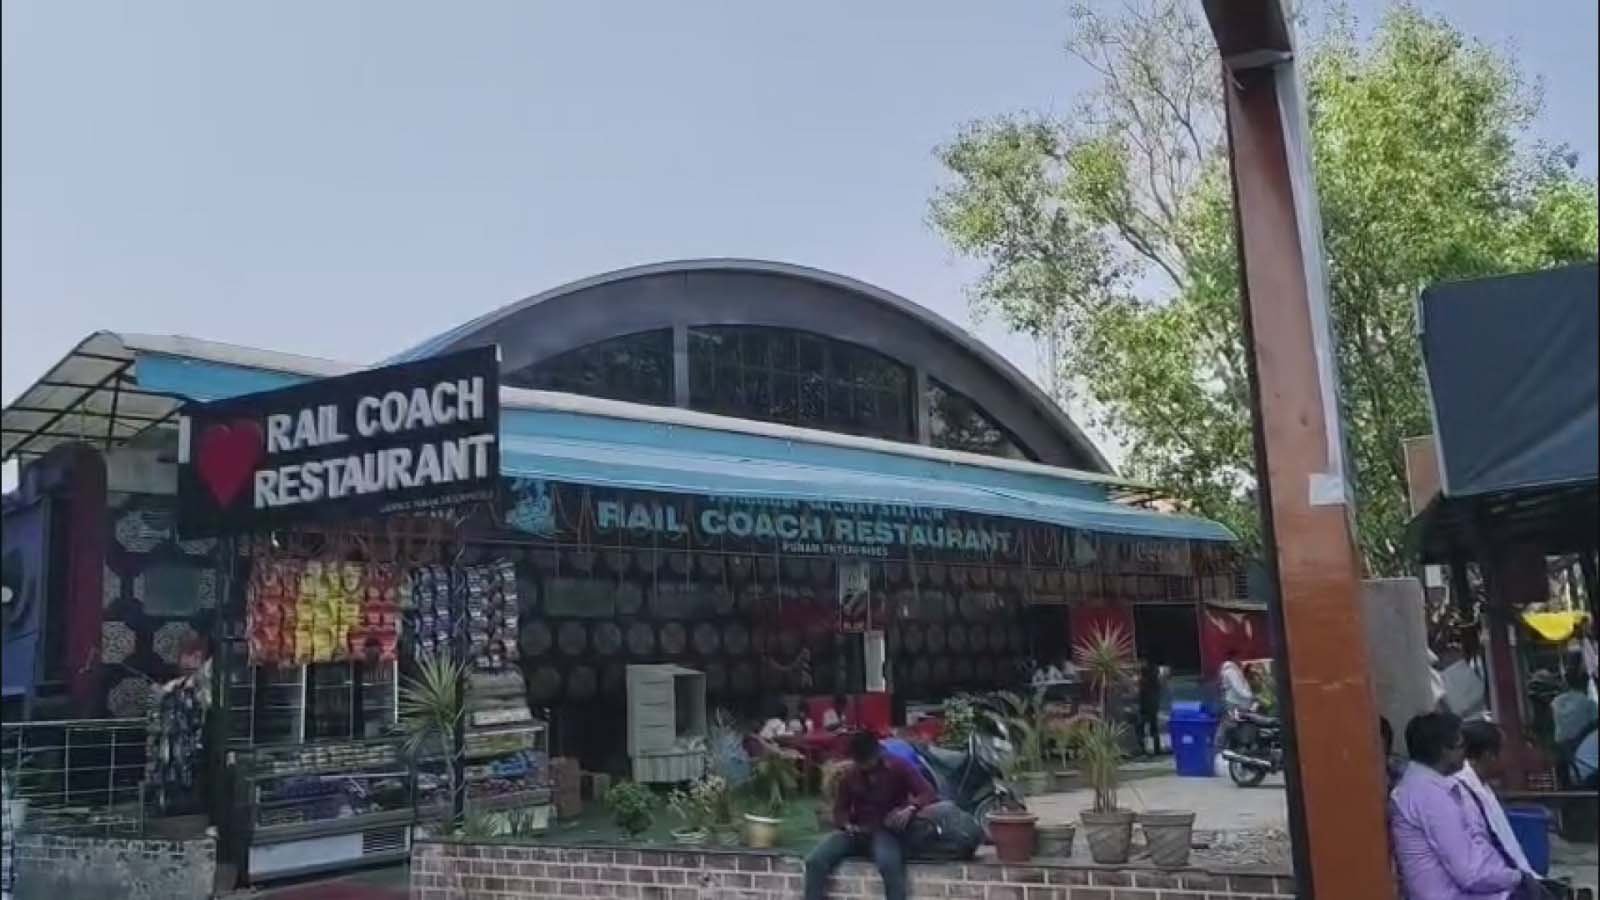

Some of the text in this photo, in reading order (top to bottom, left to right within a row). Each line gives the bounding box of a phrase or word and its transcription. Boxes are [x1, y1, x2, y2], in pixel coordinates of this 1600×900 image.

[178, 376, 485, 464] I RAIL COACH
[253, 433, 496, 510] RESTAURANT
[597, 500, 688, 533] RAIL
[701, 508, 824, 541] COACH
[833, 517, 1012, 556] RESTAURANT
